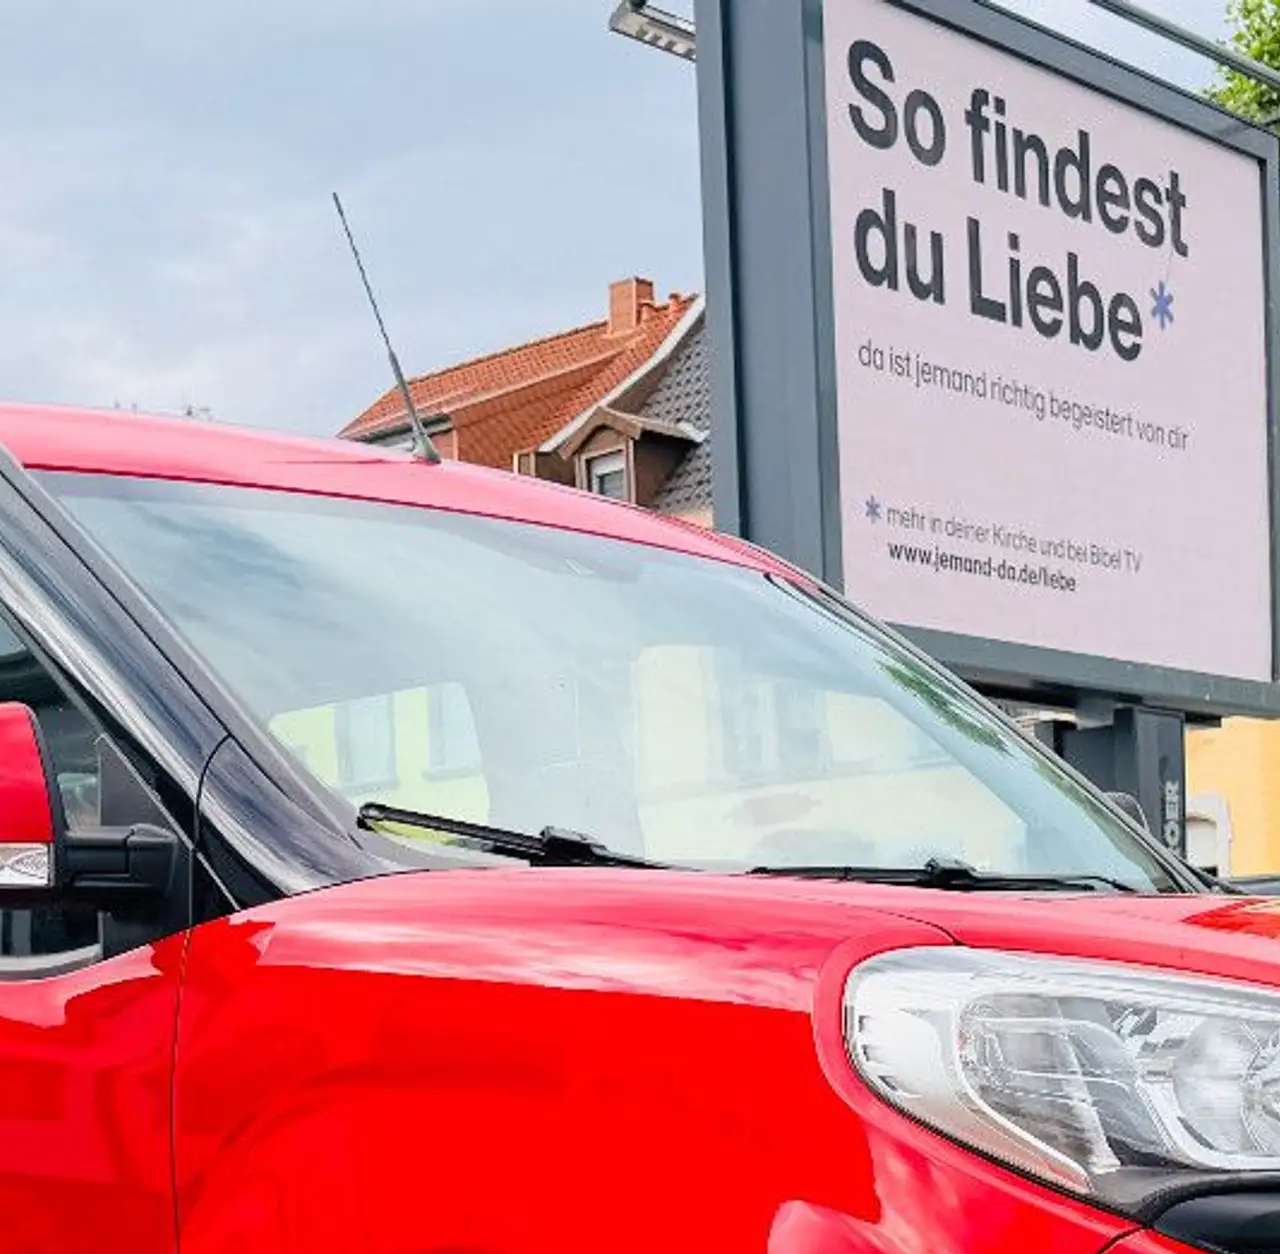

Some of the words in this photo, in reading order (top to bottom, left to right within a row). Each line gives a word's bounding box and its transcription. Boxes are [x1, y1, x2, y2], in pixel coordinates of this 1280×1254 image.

[847, 38, 946, 167] So
[964, 87, 1189, 259] findest
[854, 186, 946, 306] du
[857, 337, 885, 371] da
[888, 345, 911, 378] ist
[914, 353, 988, 399] jemand
[989, 374, 1046, 421] richtig
[1048, 391, 1134, 437] begeistert
[1136, 420, 1165, 445] von
[1167, 427, 1189, 451] dir
[886, 507, 926, 532] mehr
[929, 516, 944, 534] in
[945, 516, 991, 544] deiner
[992, 522, 1037, 554] Kirche
[1039, 538, 1066, 560] und
[1066, 539, 1089, 564] bei
[1089, 543, 1122, 571] Bibel
[1123, 547, 1144, 575] TV
[887, 542, 1077, 592] www.jemand-da.de/liebe
